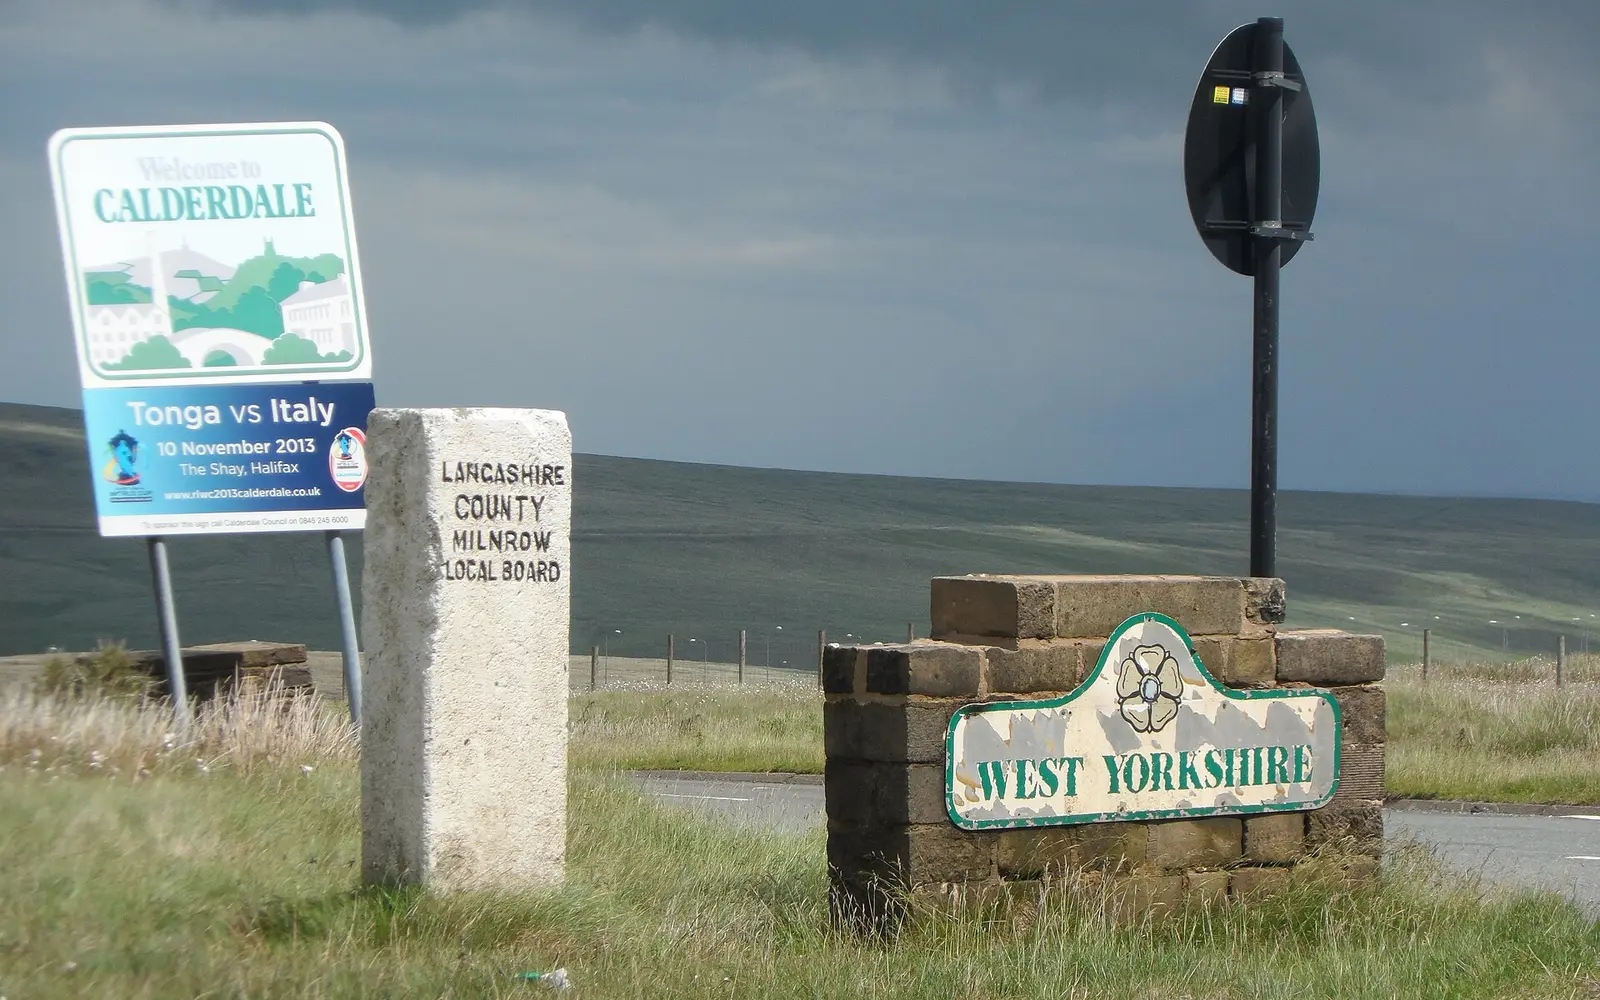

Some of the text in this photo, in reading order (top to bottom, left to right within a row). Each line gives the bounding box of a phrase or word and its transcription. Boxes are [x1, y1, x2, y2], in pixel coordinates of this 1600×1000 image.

[137, 156, 261, 181] Welcome to
[94, 183, 316, 223] CALDERDALE
[126, 397, 335, 430] Tonga vs Italy
[157, 438, 316, 457] 10 November 2013
[180, 460, 299, 478] The Shay, Halifax
[442, 461, 565, 486] LANCASHIRE
[455, 494, 545, 521] COUNTY
[225, 518, 260, 526] Calderdale
[453, 530, 551, 553] MILNROW
[442, 559, 561, 582] LOCAL BOARD
[977, 744, 1314, 800] WEST YORKSHIRE
